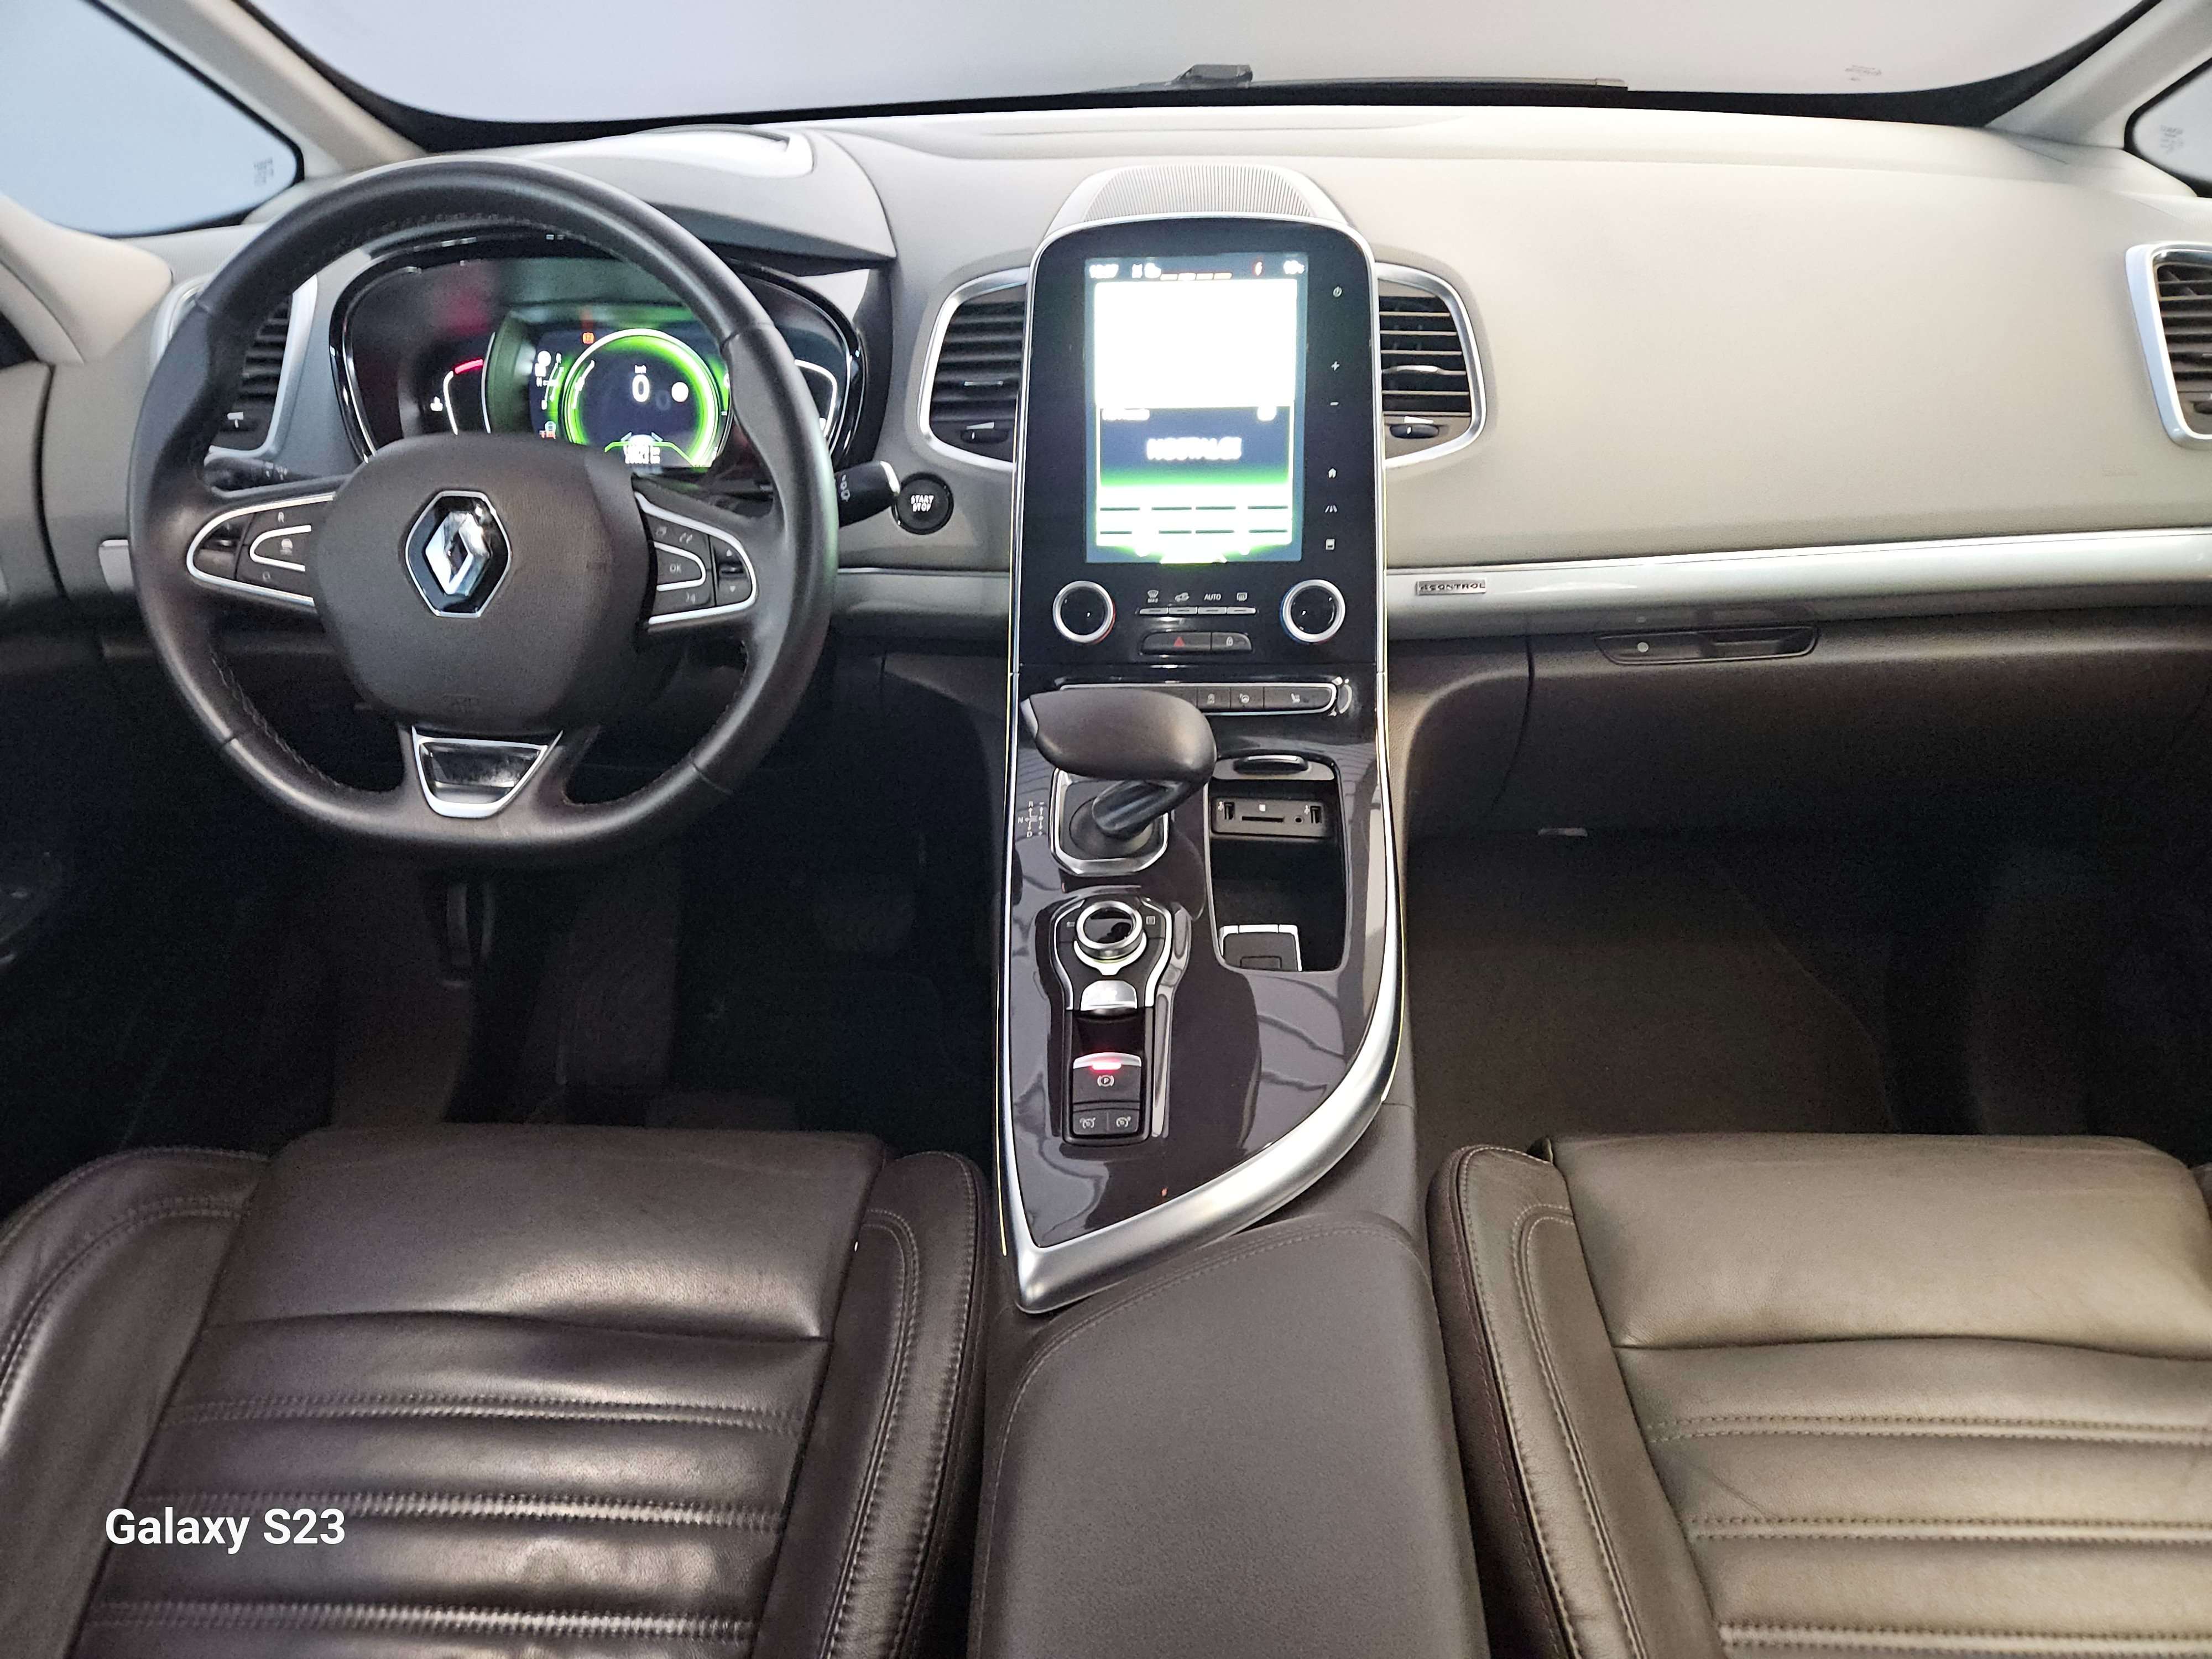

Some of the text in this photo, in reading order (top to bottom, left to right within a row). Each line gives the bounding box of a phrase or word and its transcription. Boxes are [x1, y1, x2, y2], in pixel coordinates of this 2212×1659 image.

[911, 494, 934, 504] START
[912, 503, 931, 512] STOP
[278, 512, 285, 523] R
[670, 564, 682, 574] OK
[1203, 593, 1222, 602] AUTO
